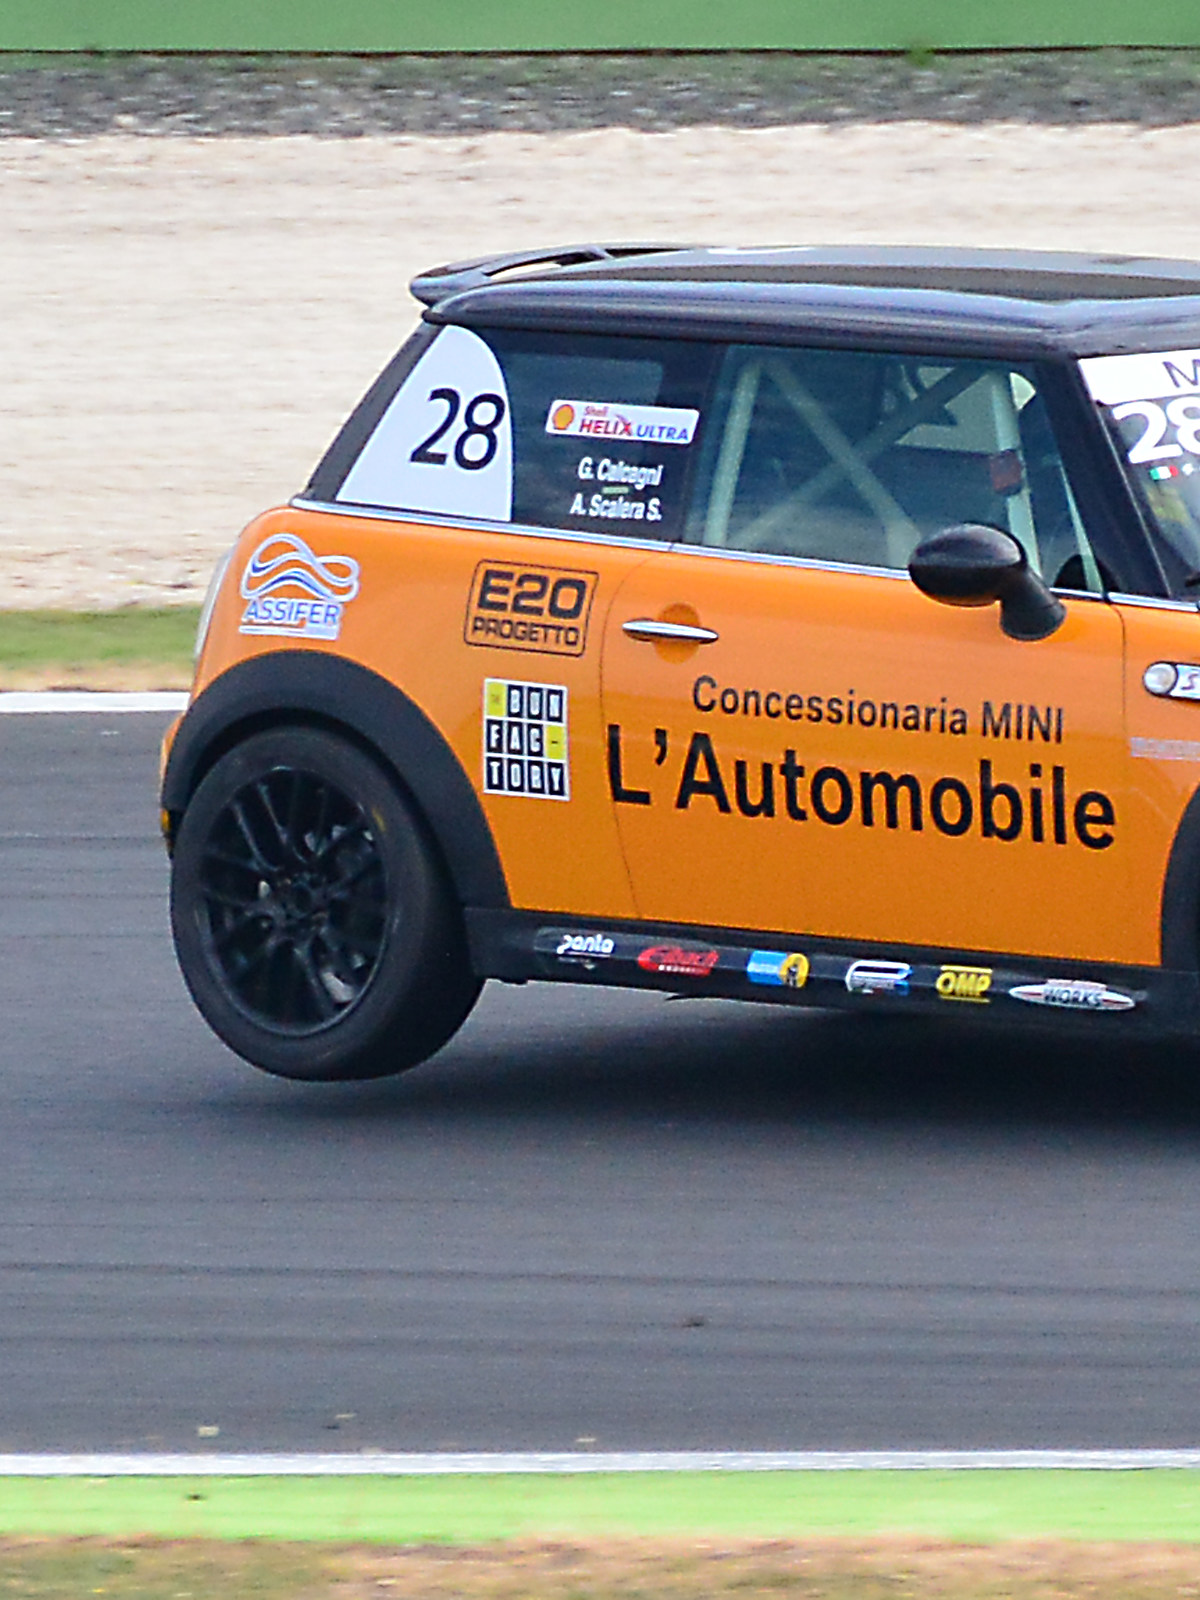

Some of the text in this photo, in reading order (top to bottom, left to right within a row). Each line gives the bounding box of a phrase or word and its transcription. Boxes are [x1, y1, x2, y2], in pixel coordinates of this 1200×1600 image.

[409, 387, 506, 471] 28
[578, 414, 689, 441] HELIX ULTRA
[569, 493, 587, 516] A.
[477, 569, 587, 619] E20
[245, 600, 341, 624] ASSIFER
[472, 616, 580, 646] PROGETTO
[692, 675, 1063, 744] Concessionaria MINI
[489, 761, 561, 791] TORY
[606, 723, 1116, 850] L'Automobile
[936, 971, 991, 996] OMP
